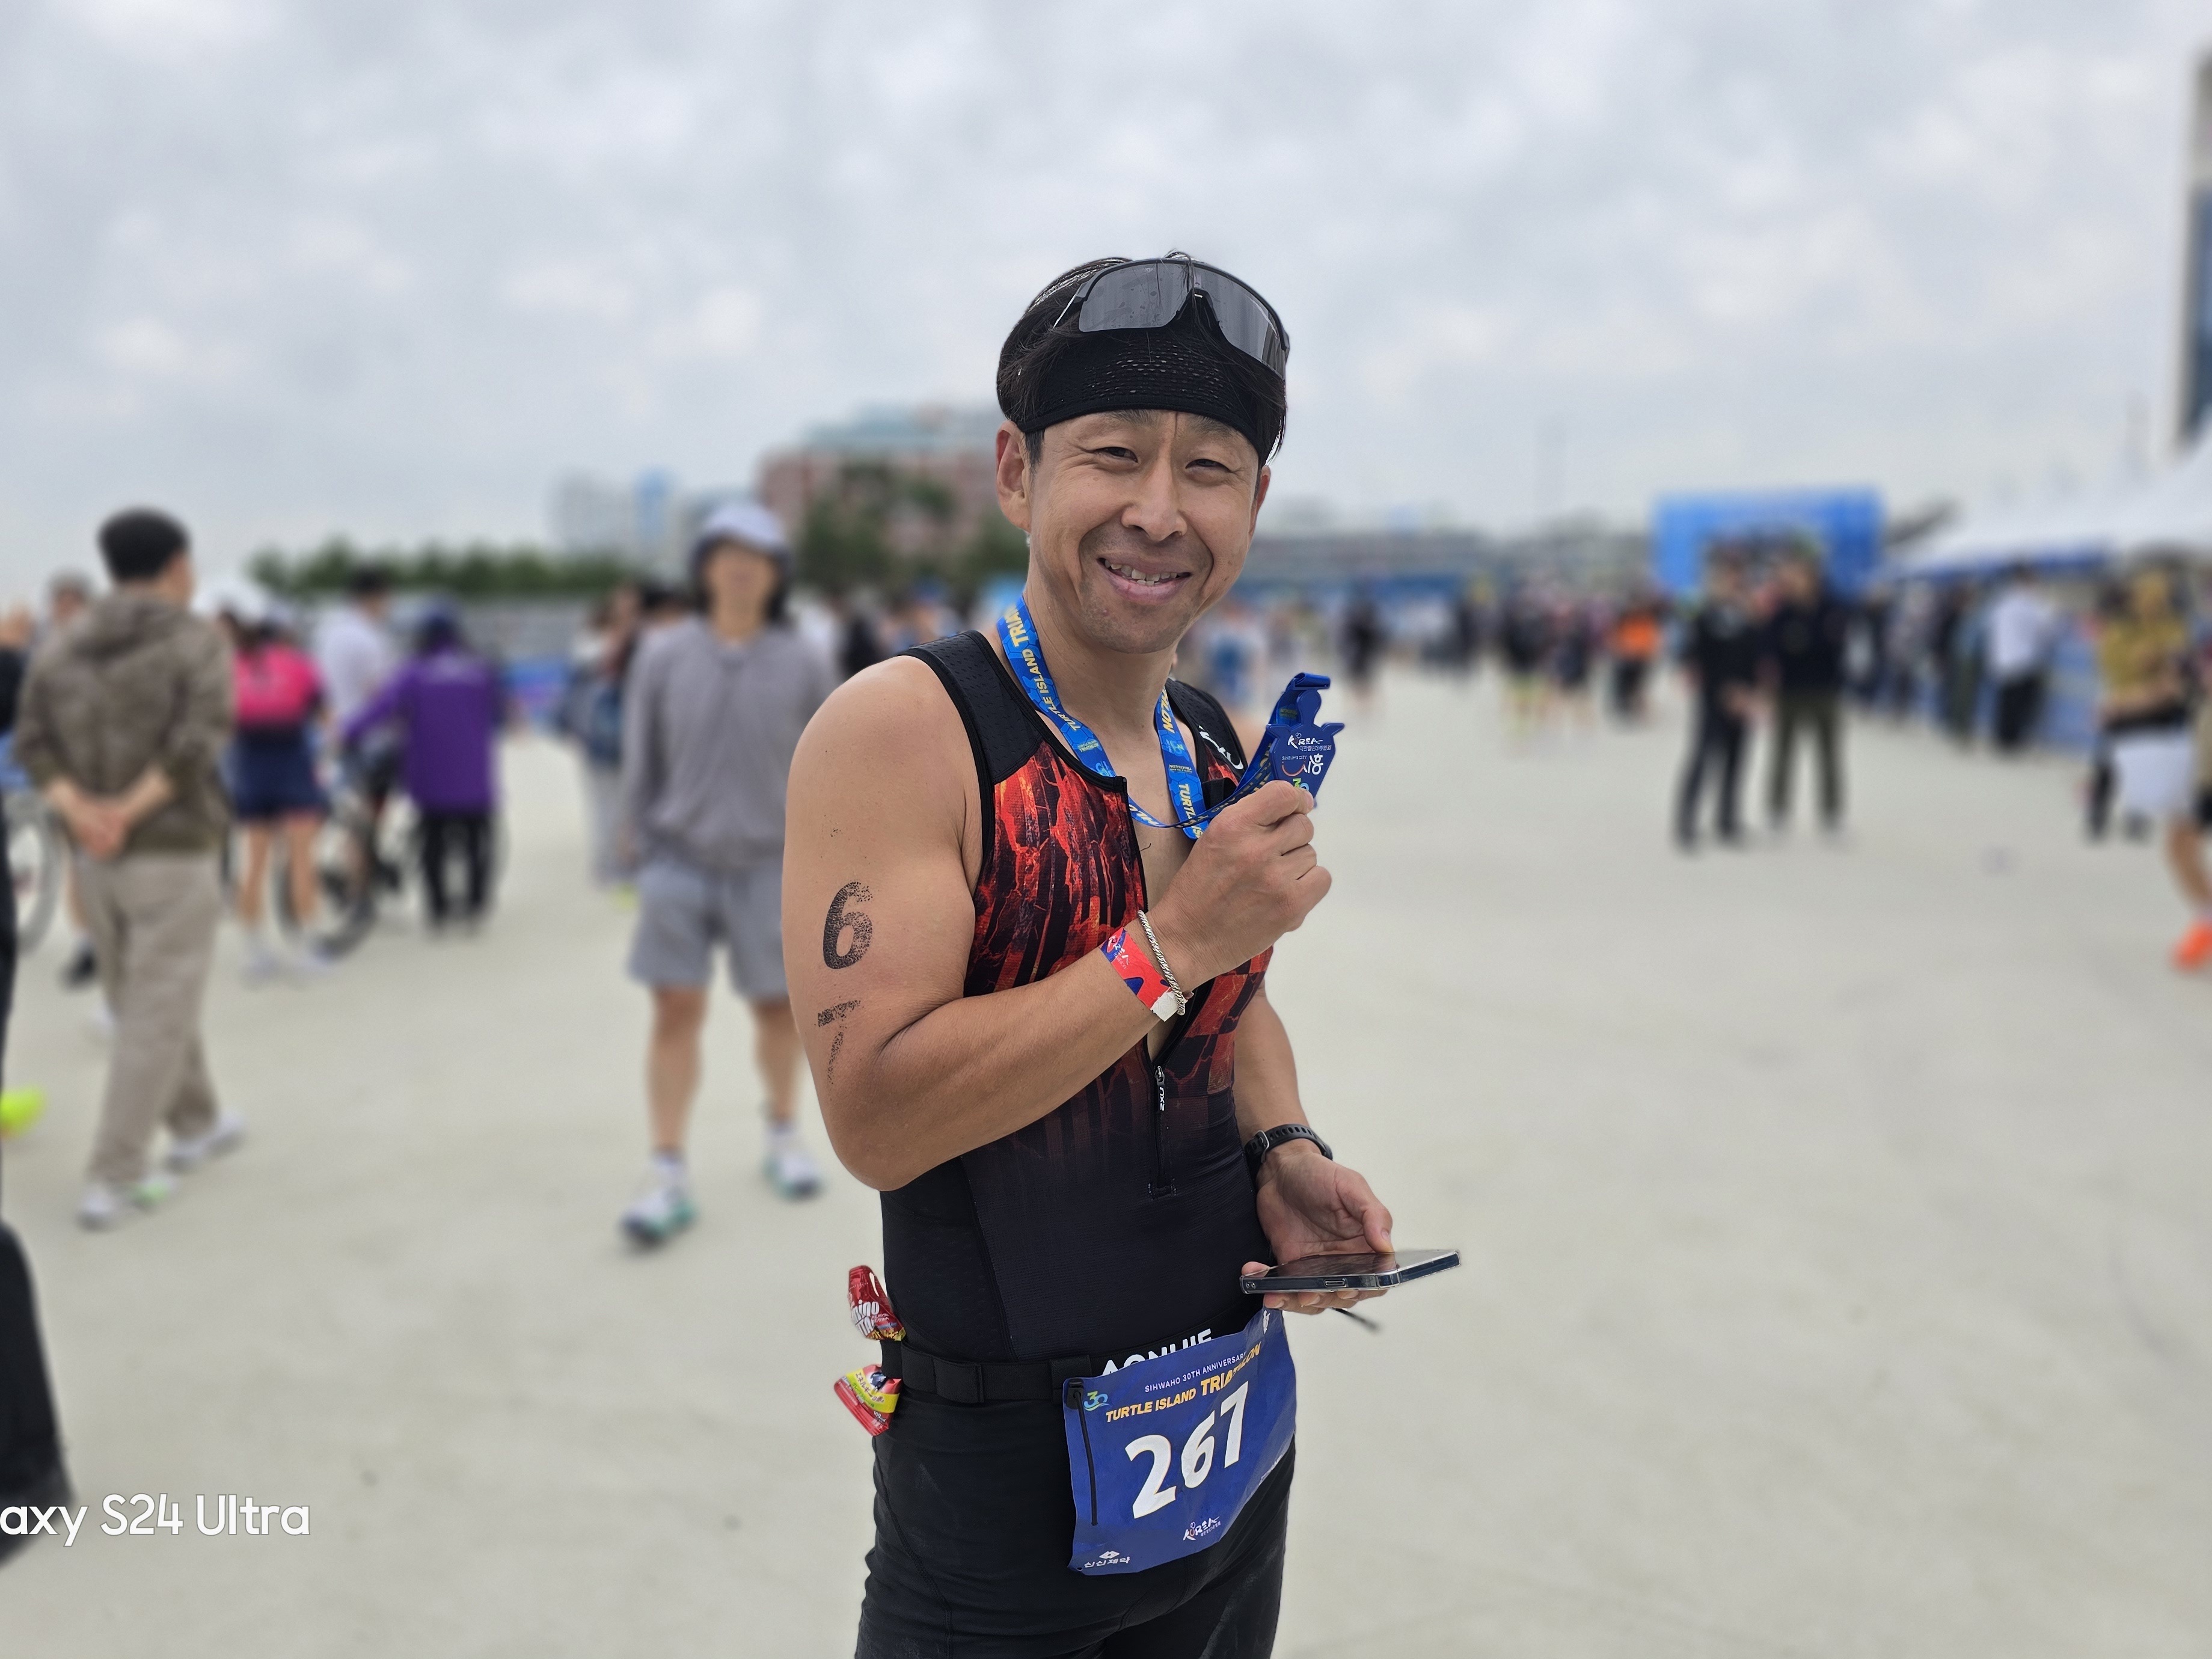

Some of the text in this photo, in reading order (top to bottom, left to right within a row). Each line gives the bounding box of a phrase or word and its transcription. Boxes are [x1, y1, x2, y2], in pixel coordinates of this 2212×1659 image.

[1022, 648, 1050, 694] ISLAND
[1178, 783, 1198, 820] TURTL
[1144, 1376, 1175, 1393] SIHWAHO
[1181, 1368, 1201, 1383] 30TH
[1105, 1400, 1153, 1423] TURTLE
[1154, 1387, 1197, 1412] ISLAND
[1124, 1381, 1249, 1519] 267
